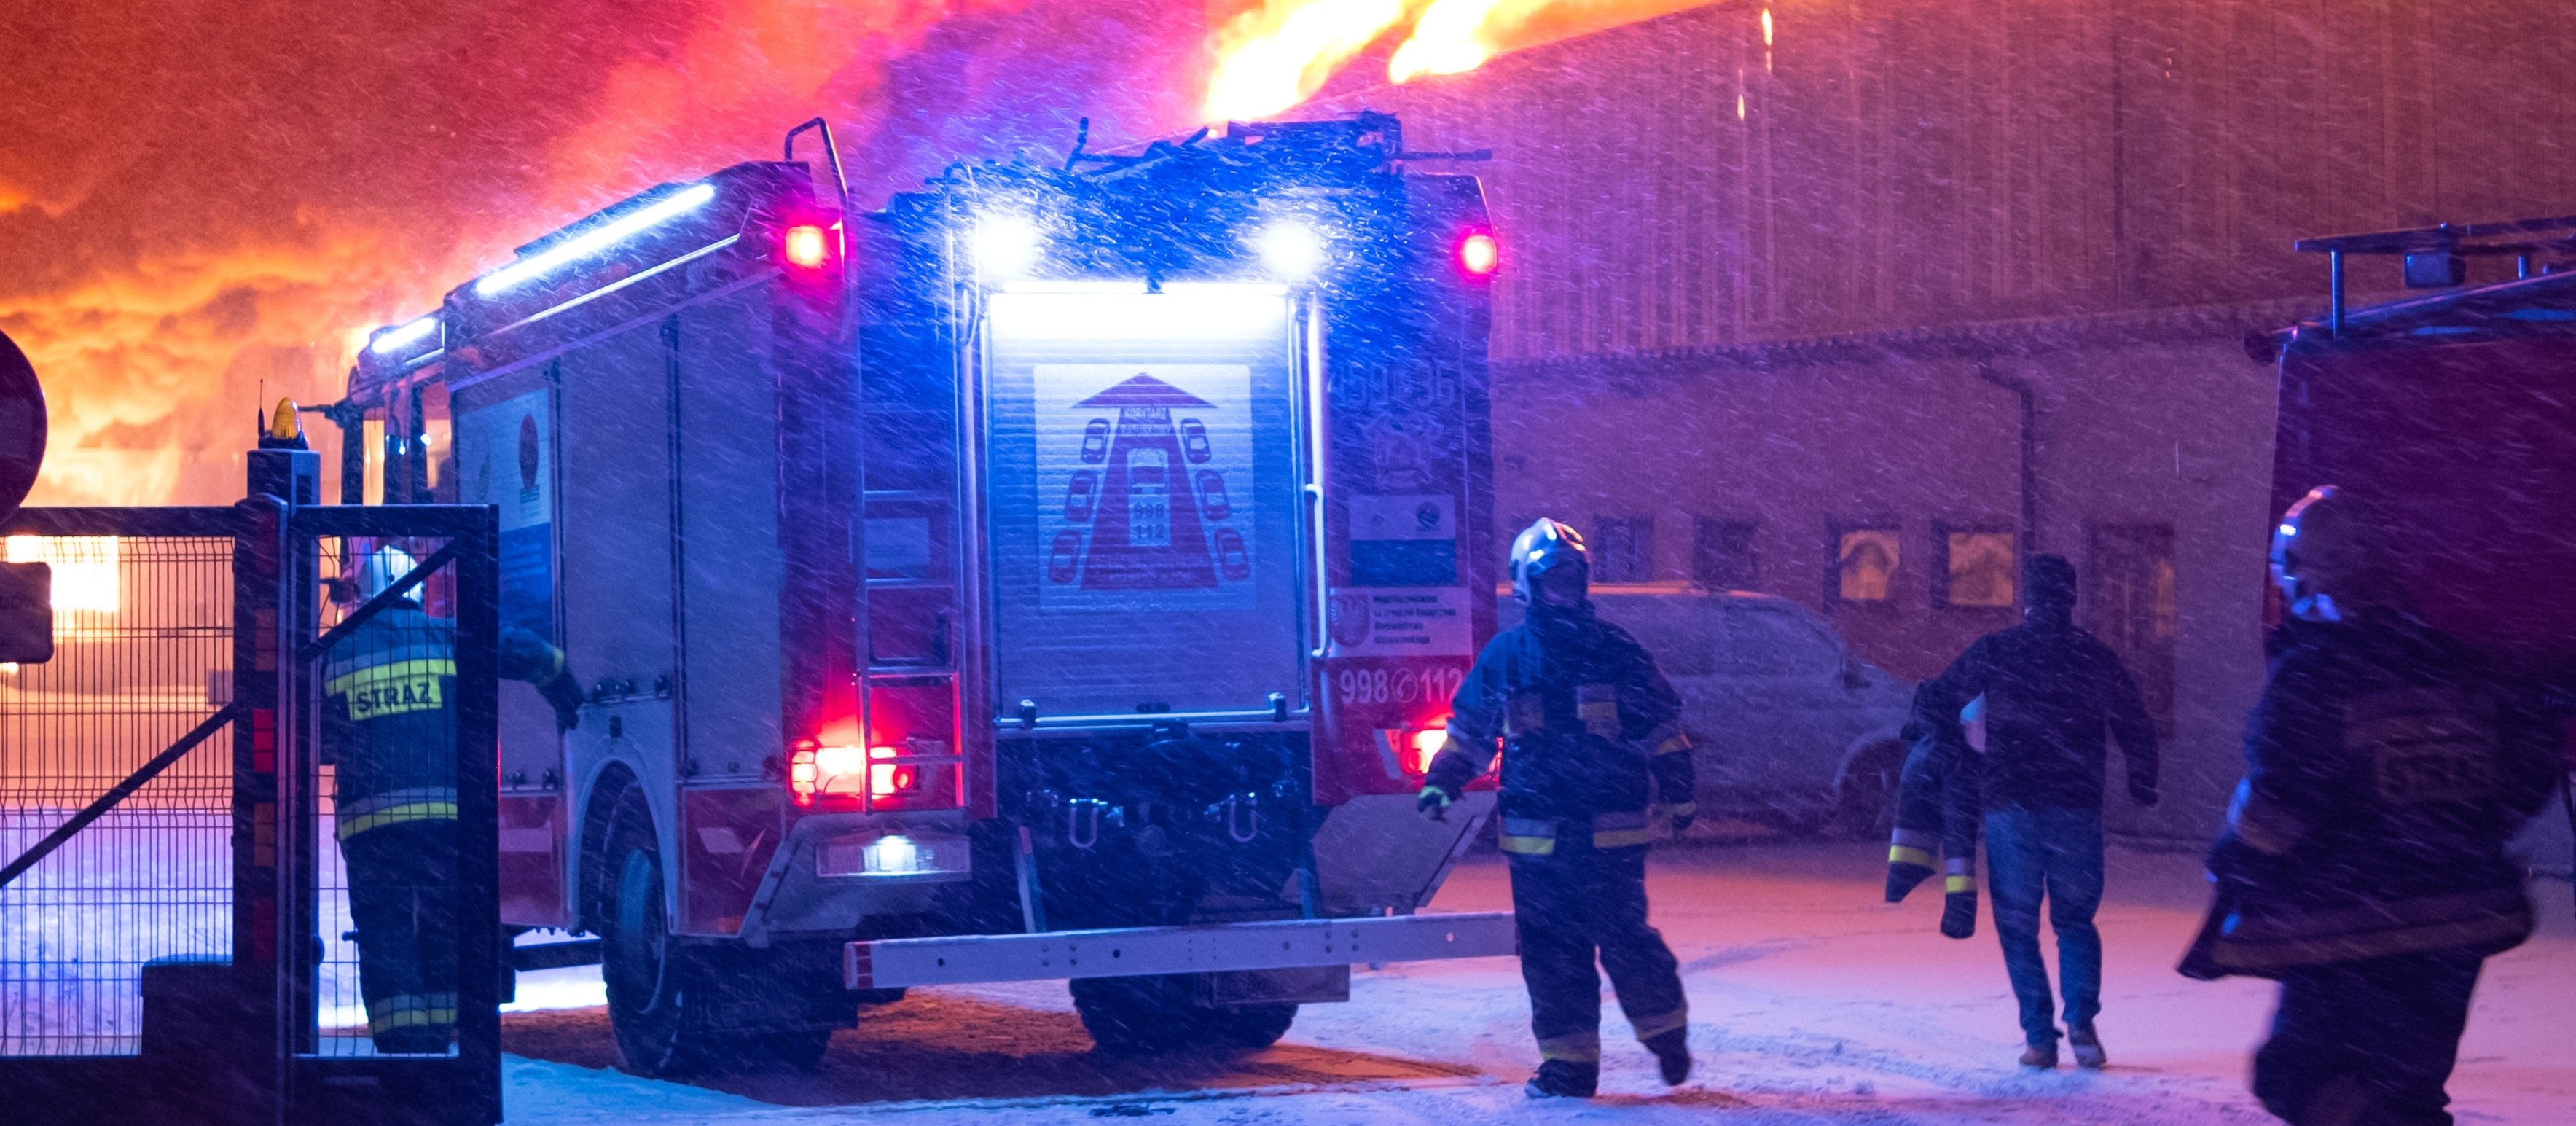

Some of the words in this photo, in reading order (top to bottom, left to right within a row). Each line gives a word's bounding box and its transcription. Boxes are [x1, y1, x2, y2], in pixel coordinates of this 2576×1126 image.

[1133, 524, 1164, 539] 112
[1339, 668, 1388, 705] 998
[1421, 668, 1463, 703] 112
